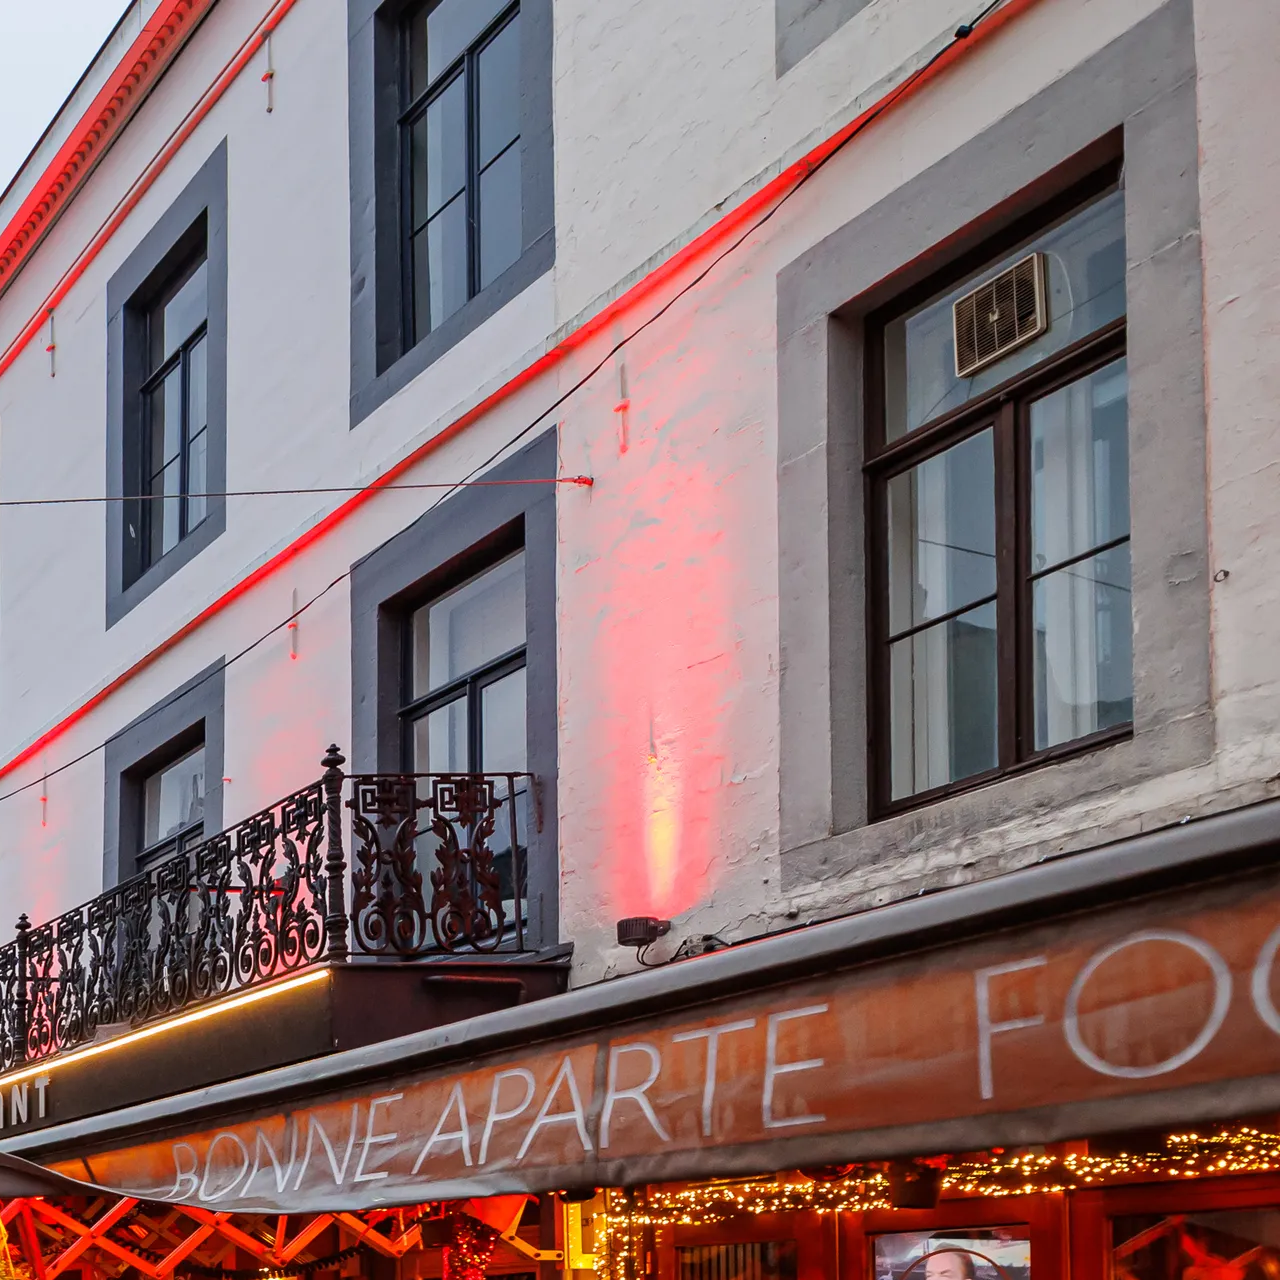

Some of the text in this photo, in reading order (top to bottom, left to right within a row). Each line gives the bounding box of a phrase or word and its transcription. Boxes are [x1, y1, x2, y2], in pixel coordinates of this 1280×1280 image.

[170, 1003, 829, 1201] BONNE APARTE
[975, 923, 1280, 1099] FO
